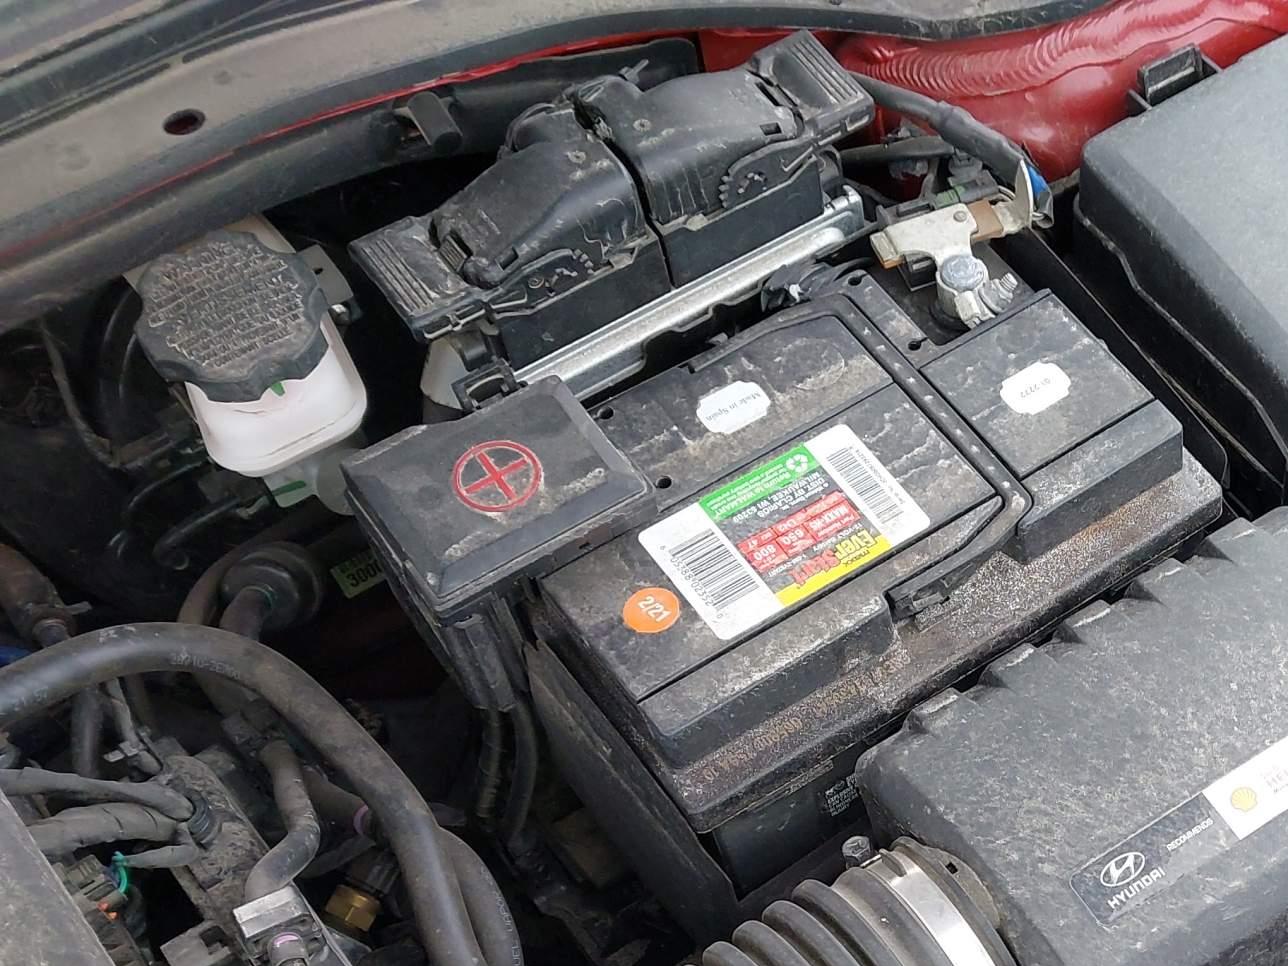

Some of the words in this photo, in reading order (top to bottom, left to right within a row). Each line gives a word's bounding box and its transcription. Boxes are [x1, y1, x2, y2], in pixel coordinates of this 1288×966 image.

[766, 469, 821, 504] MILWAUKEE,
[791, 487, 806, 498] BY
[755, 498, 770, 510] WI
[780, 527, 805, 546] 650
[751, 543, 777, 562] 800
[636, 594, 672, 622] 2/21
[1165, 815, 1215, 853] RECOMMENDS
[1106, 865, 1166, 910] HYUNDAI
